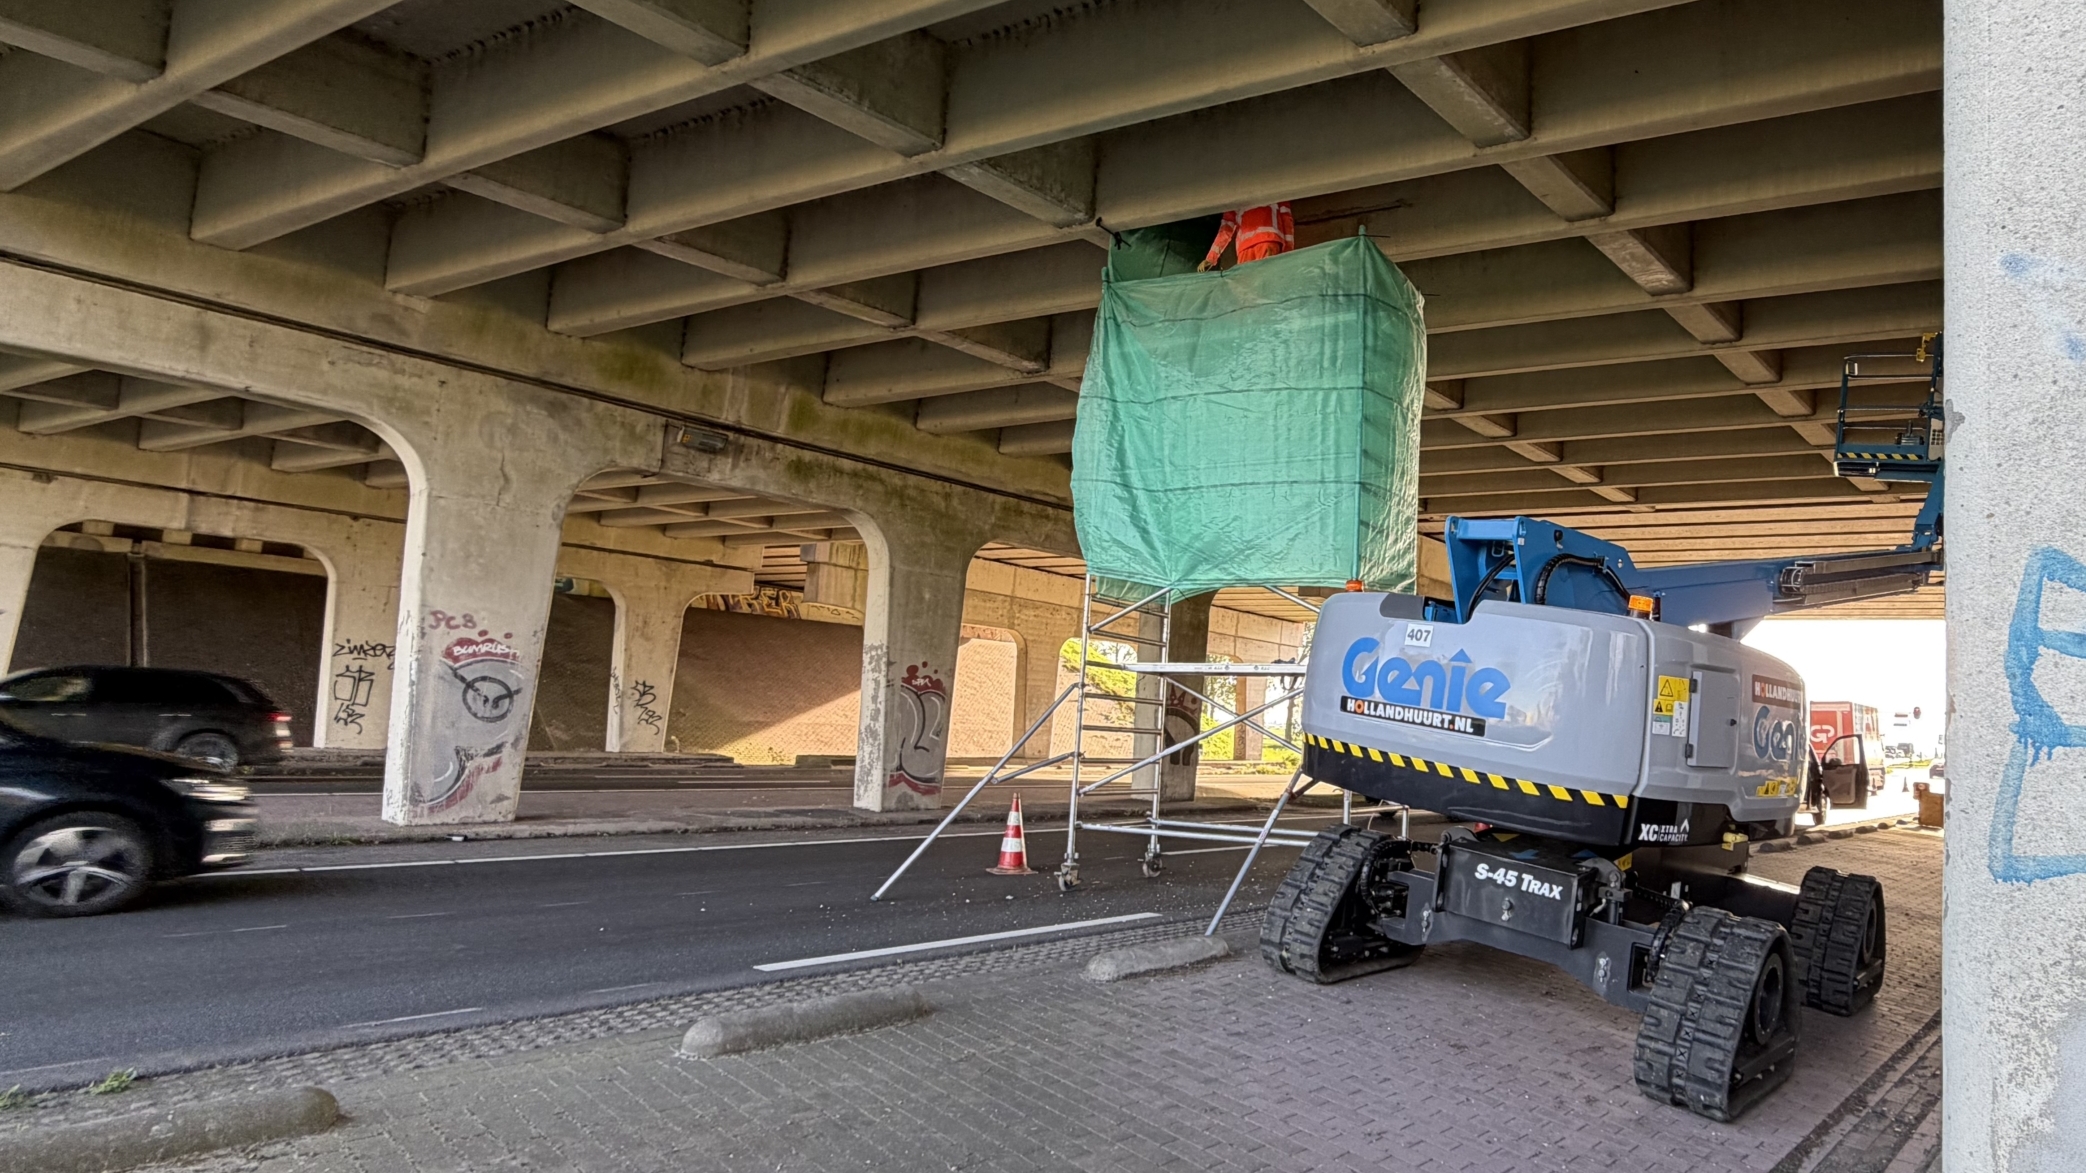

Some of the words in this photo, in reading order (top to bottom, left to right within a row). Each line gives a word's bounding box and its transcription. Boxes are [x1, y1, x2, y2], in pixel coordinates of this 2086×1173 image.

[1407, 628, 1431, 643] 407
[1342, 637, 1511, 720] Genie
[1346, 698, 1474, 733] HOLLANDHUURT.NL
[1638, 823, 1659, 842] XC
[1660, 825, 1678, 833] XTRA
[1474, 863, 1518, 888] S-45
